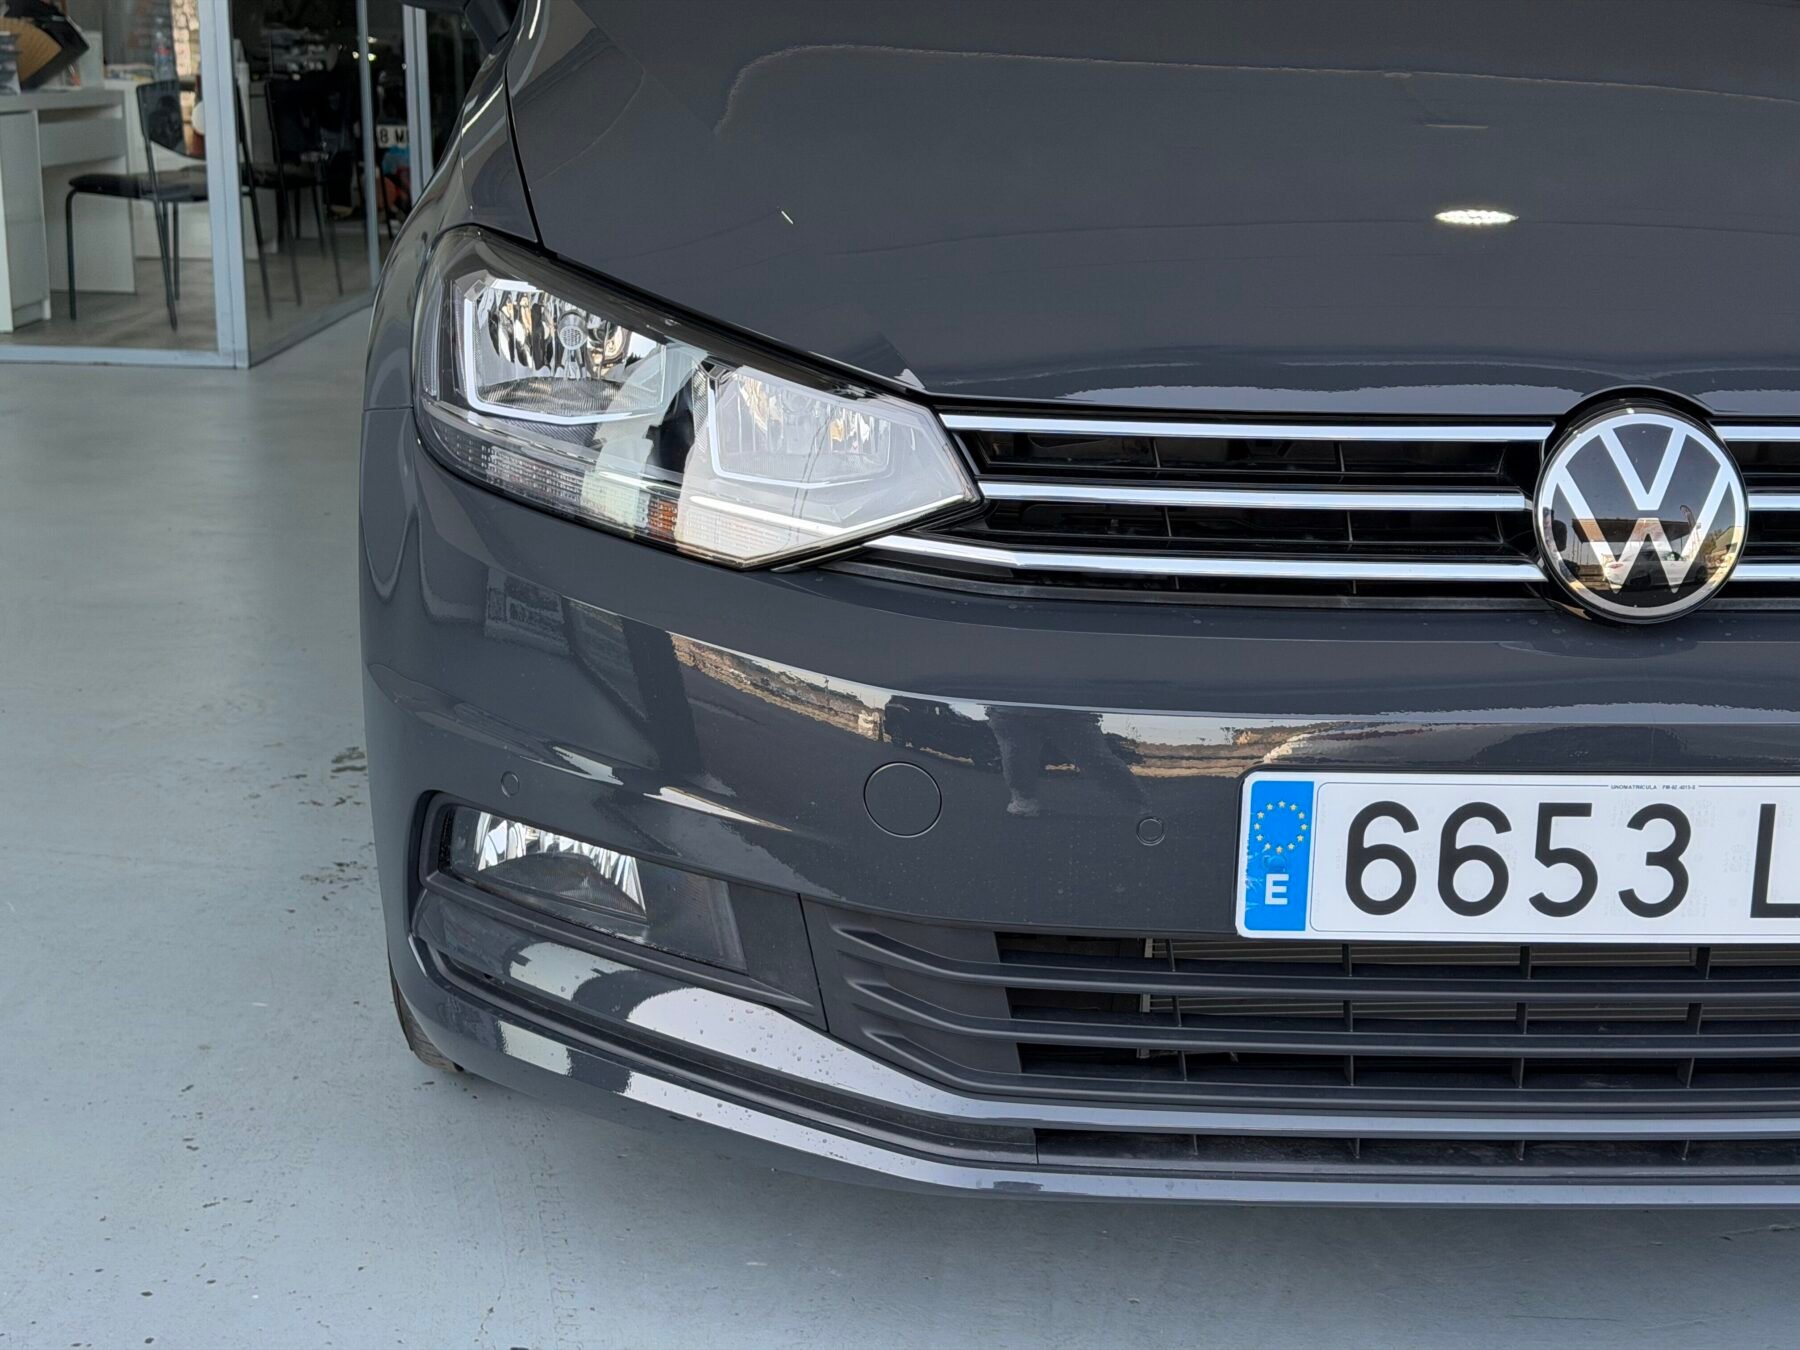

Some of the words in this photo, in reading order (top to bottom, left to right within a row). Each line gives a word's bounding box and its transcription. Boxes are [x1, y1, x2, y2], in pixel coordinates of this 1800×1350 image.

[1264, 873, 1289, 905] E
[1346, 801, 1691, 917] 6653
[1750, 803, 1800, 919] L
